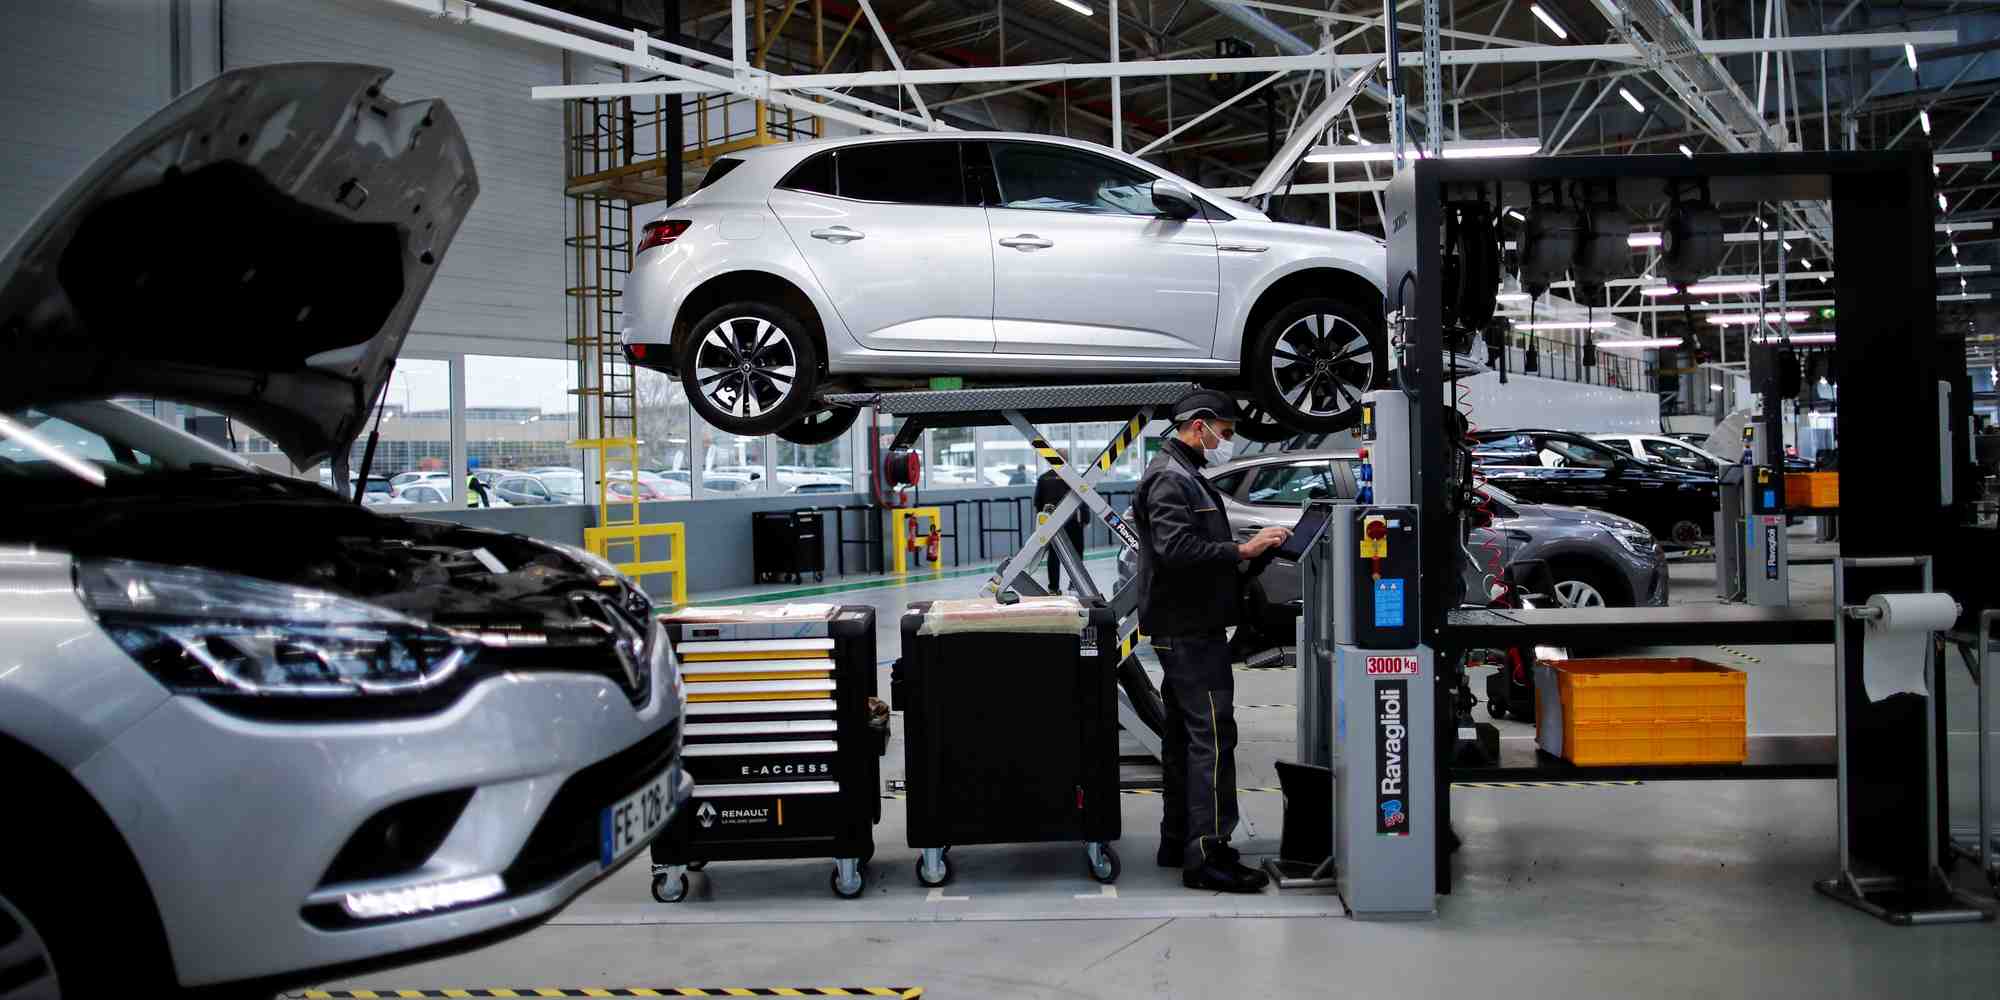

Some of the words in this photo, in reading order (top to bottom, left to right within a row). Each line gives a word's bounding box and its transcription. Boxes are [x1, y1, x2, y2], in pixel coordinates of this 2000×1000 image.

[1368, 657, 1402, 674] 3000
[1403, 657, 1417, 674] kg
[1380, 689, 1406, 795] Ravaglioli
[741, 763, 829, 776] E-ACCESS
[614, 773, 674, 853] FE-126-J
[721, 808, 769, 818] RENAULT
